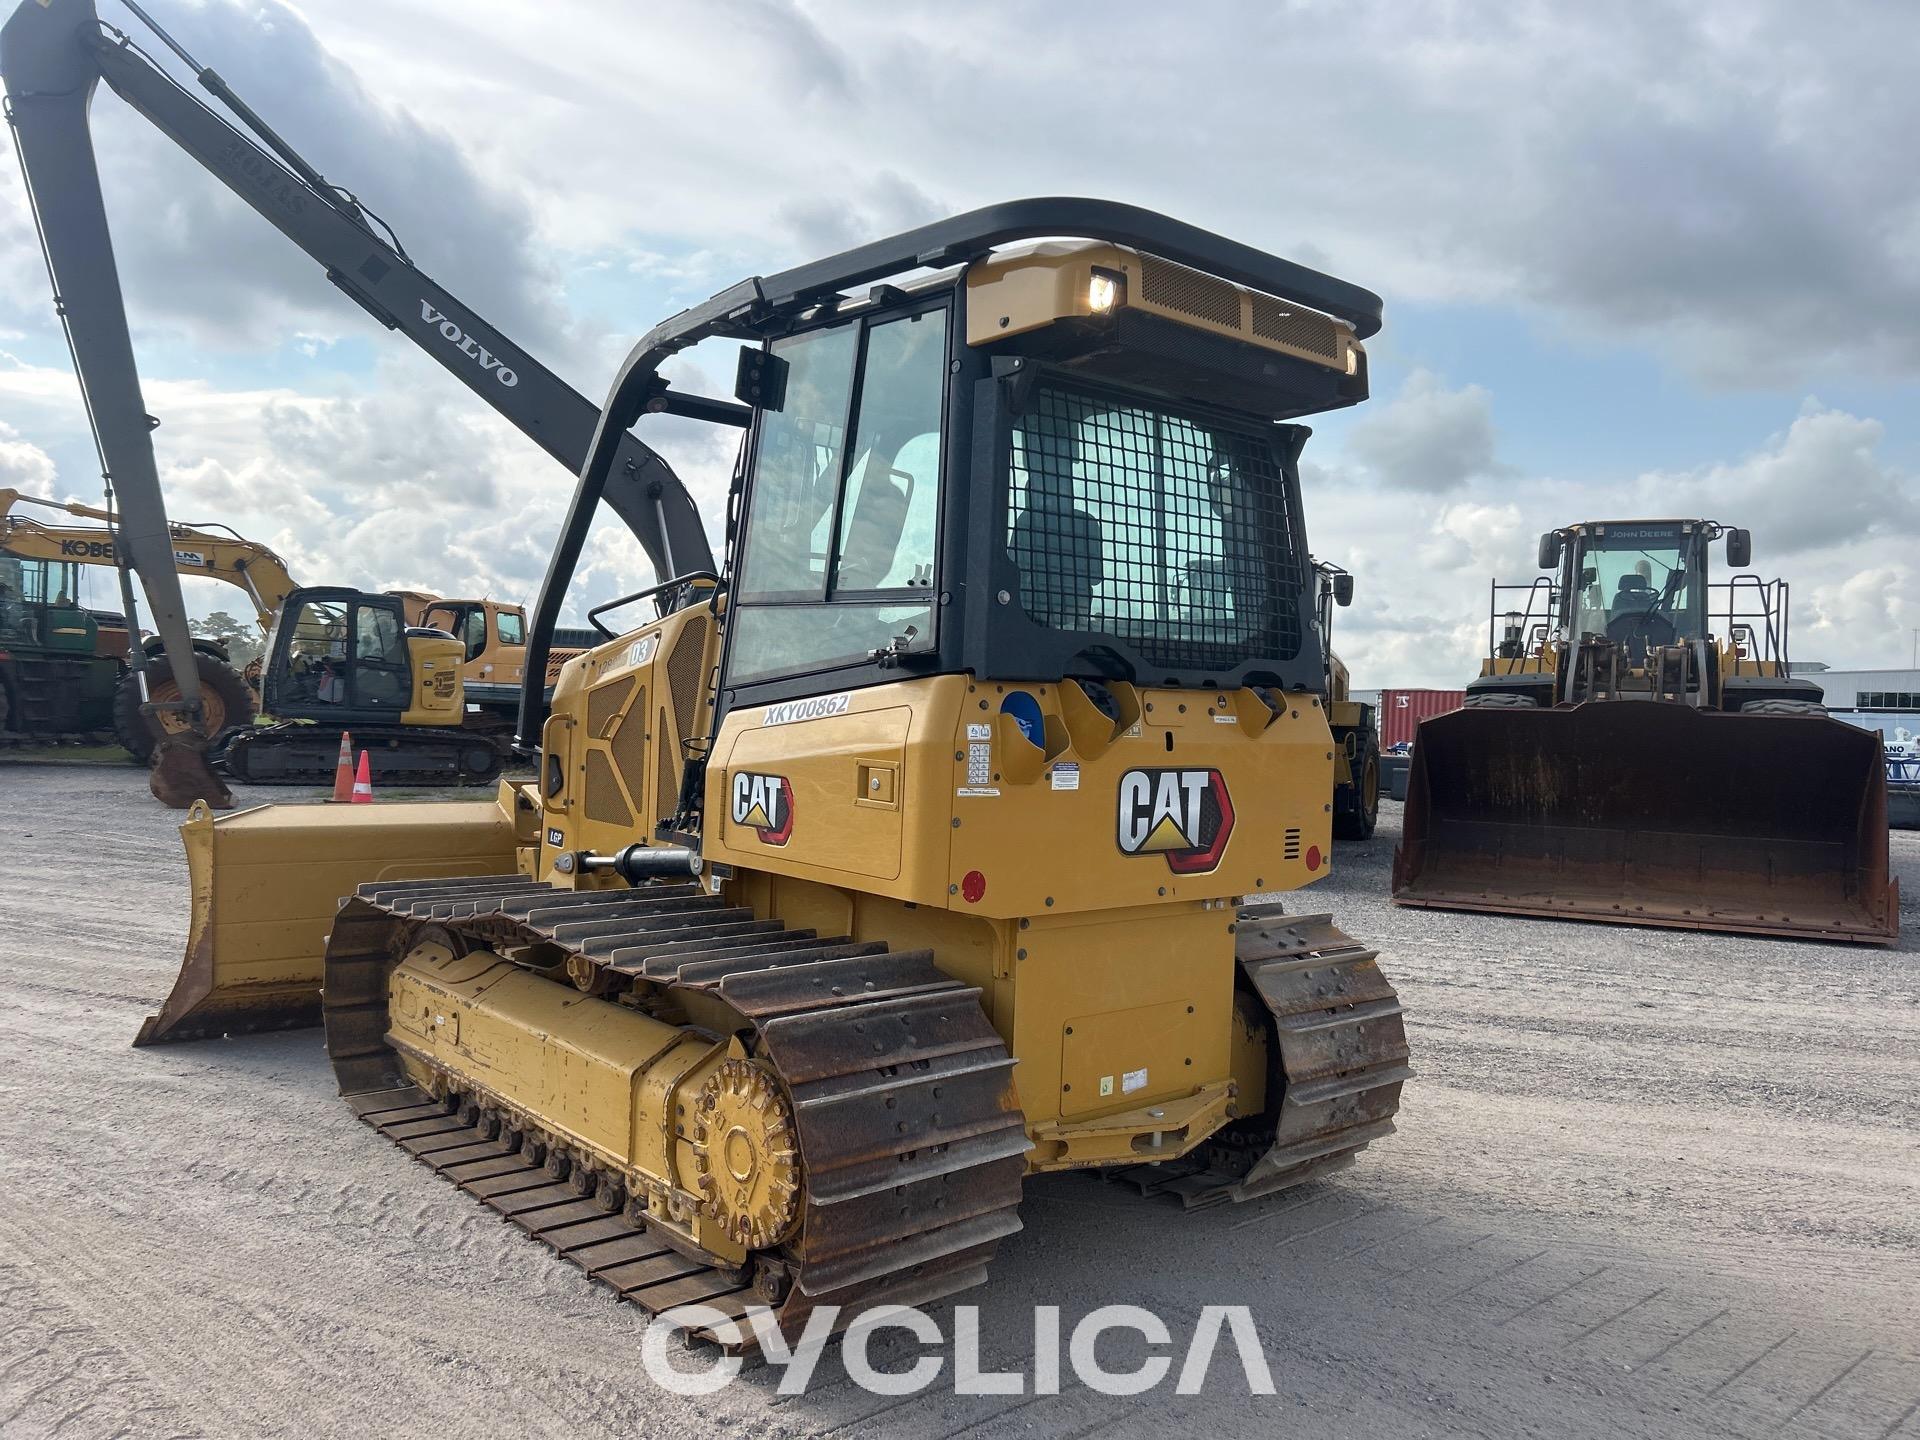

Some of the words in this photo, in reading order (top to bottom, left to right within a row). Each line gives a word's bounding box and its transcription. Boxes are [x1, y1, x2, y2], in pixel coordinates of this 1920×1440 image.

[420, 299, 518, 387] VOLVO
[1610, 530, 1638, 538] JOHN
[1639, 530, 1674, 538] DEERE
[631, 640, 649, 665] D3
[764, 694, 849, 725] XKY00862
[733, 772, 782, 828] CAT
[1119, 771, 1209, 852] CAT
[550, 831, 563, 844] LGP
